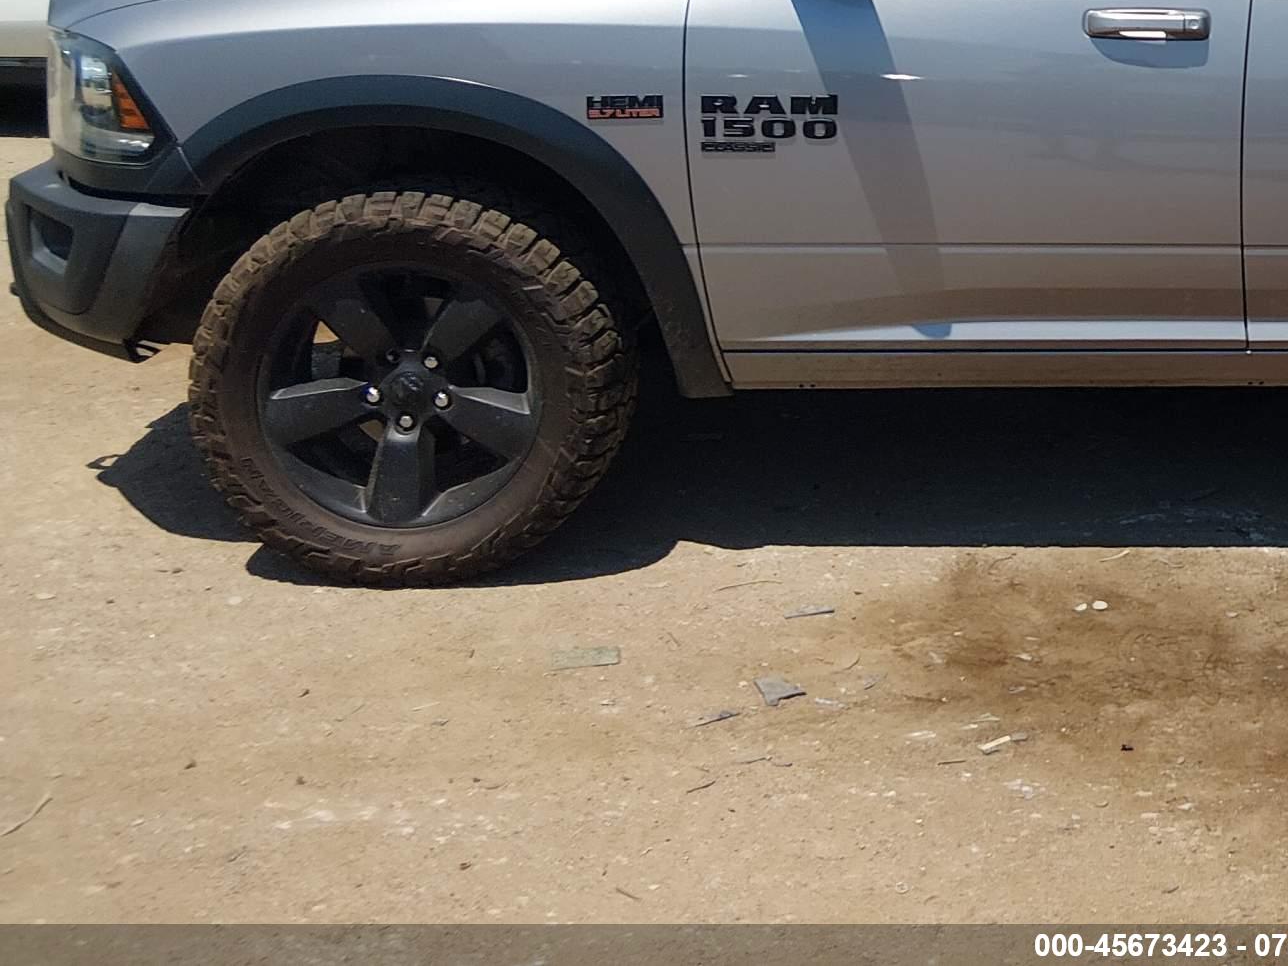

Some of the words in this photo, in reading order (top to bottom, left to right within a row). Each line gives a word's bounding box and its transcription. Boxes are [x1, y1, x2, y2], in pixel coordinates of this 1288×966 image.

[586, 94, 663, 109] HEMI
[700, 94, 839, 115] RAM
[615, 107, 661, 118] LITER
[700, 117, 839, 140] 1500
